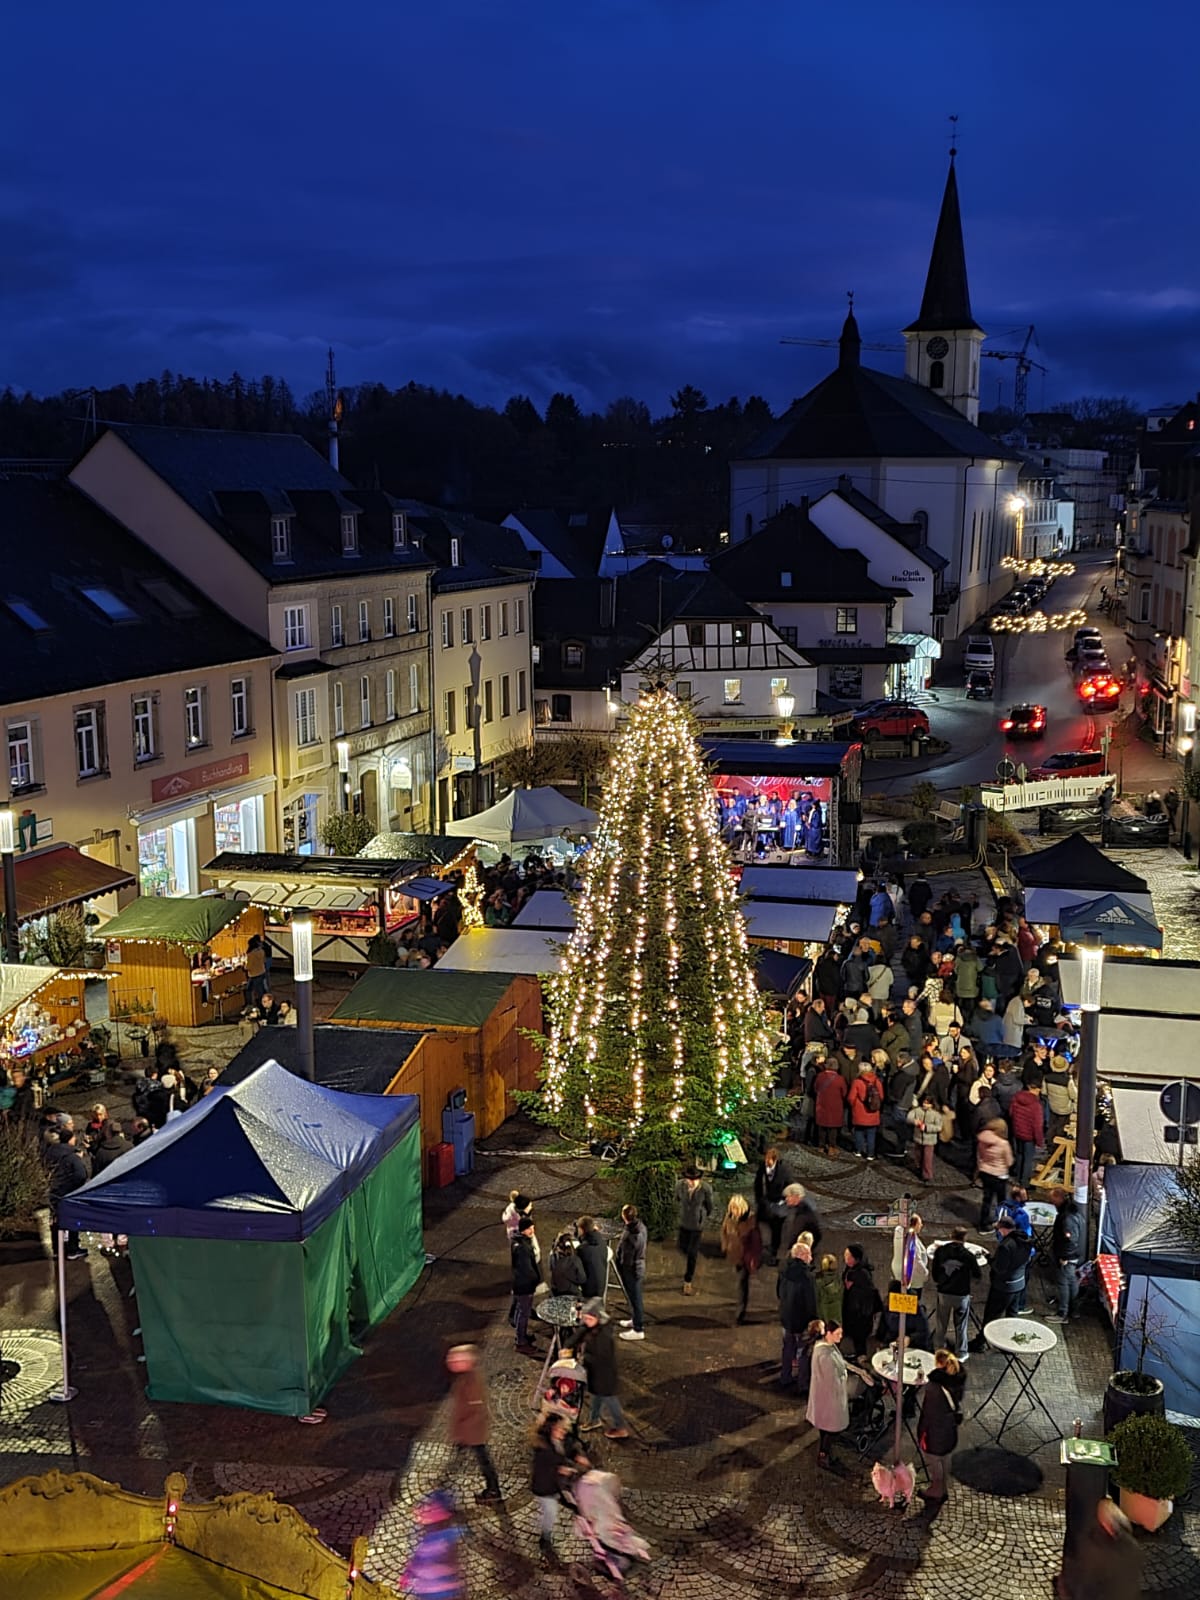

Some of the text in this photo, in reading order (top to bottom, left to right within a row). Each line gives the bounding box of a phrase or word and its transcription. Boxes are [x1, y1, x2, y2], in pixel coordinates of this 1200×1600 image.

[902, 568, 920, 577] Optik
[201, 763, 244, 783] Buchhandlung
[1095, 916, 1136, 925] adidas
